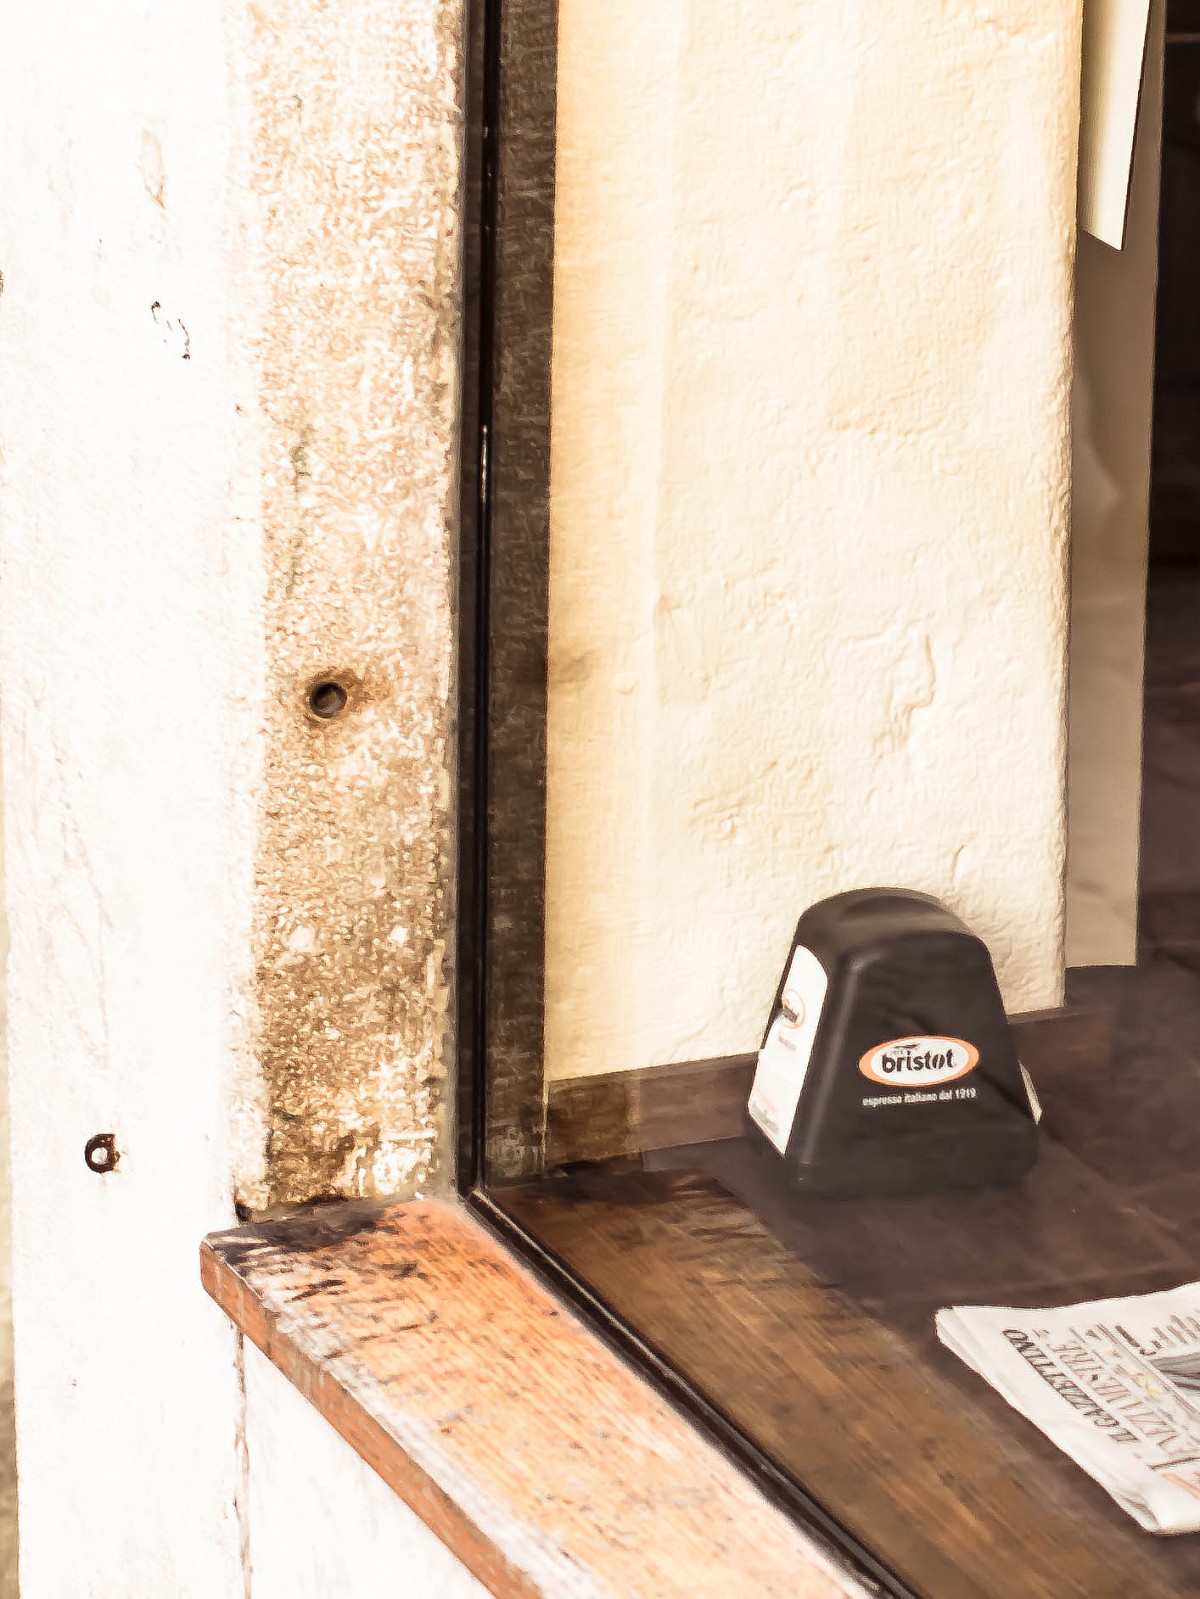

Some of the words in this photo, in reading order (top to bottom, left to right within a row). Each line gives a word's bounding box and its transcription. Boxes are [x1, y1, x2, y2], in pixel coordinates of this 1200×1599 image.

[881, 1049, 955, 1073] bristot
[862, 1095, 903, 1108] espresso
[904, 1091, 938, 1104] italiano
[939, 1089, 953, 1101] dal
[1002, 1329, 1121, 1428] GAZZETTINO
